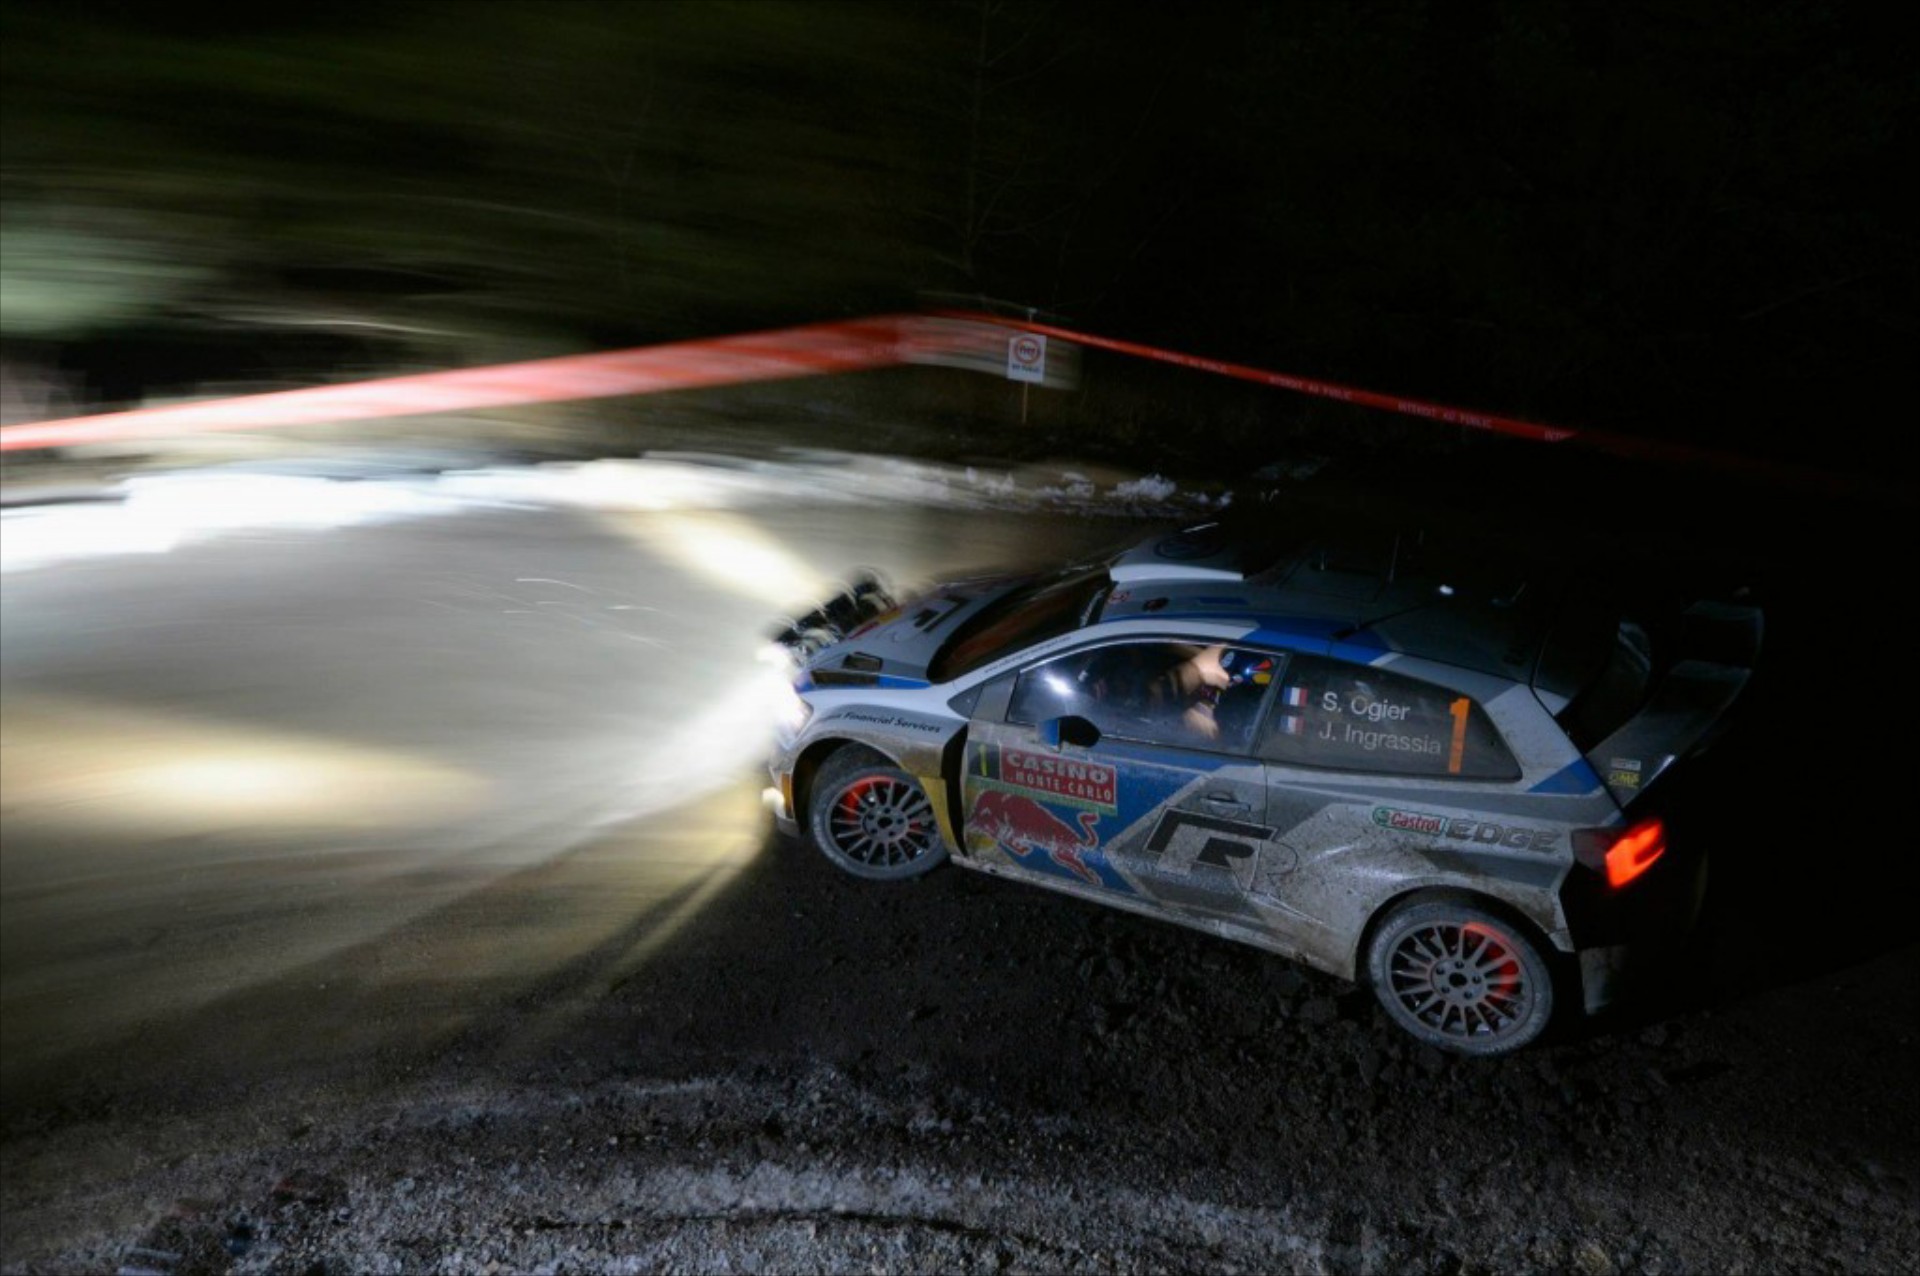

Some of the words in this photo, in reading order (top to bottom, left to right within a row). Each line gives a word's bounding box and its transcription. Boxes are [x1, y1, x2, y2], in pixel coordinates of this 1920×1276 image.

[843, 711, 894, 725] Financial
[894, 717, 941, 733] Services
[1322, 691, 1342, 713] S.
[1351, 696, 1411, 722] Ogier
[1319, 722, 1337, 741] J.
[1346, 724, 1441, 755] Ingrassia
[1449, 696, 1471, 774] 1
[1006, 752, 1109, 785] CASINO
[1390, 812, 1441, 834] Castrol
[1446, 818, 1562, 854] EDGE
